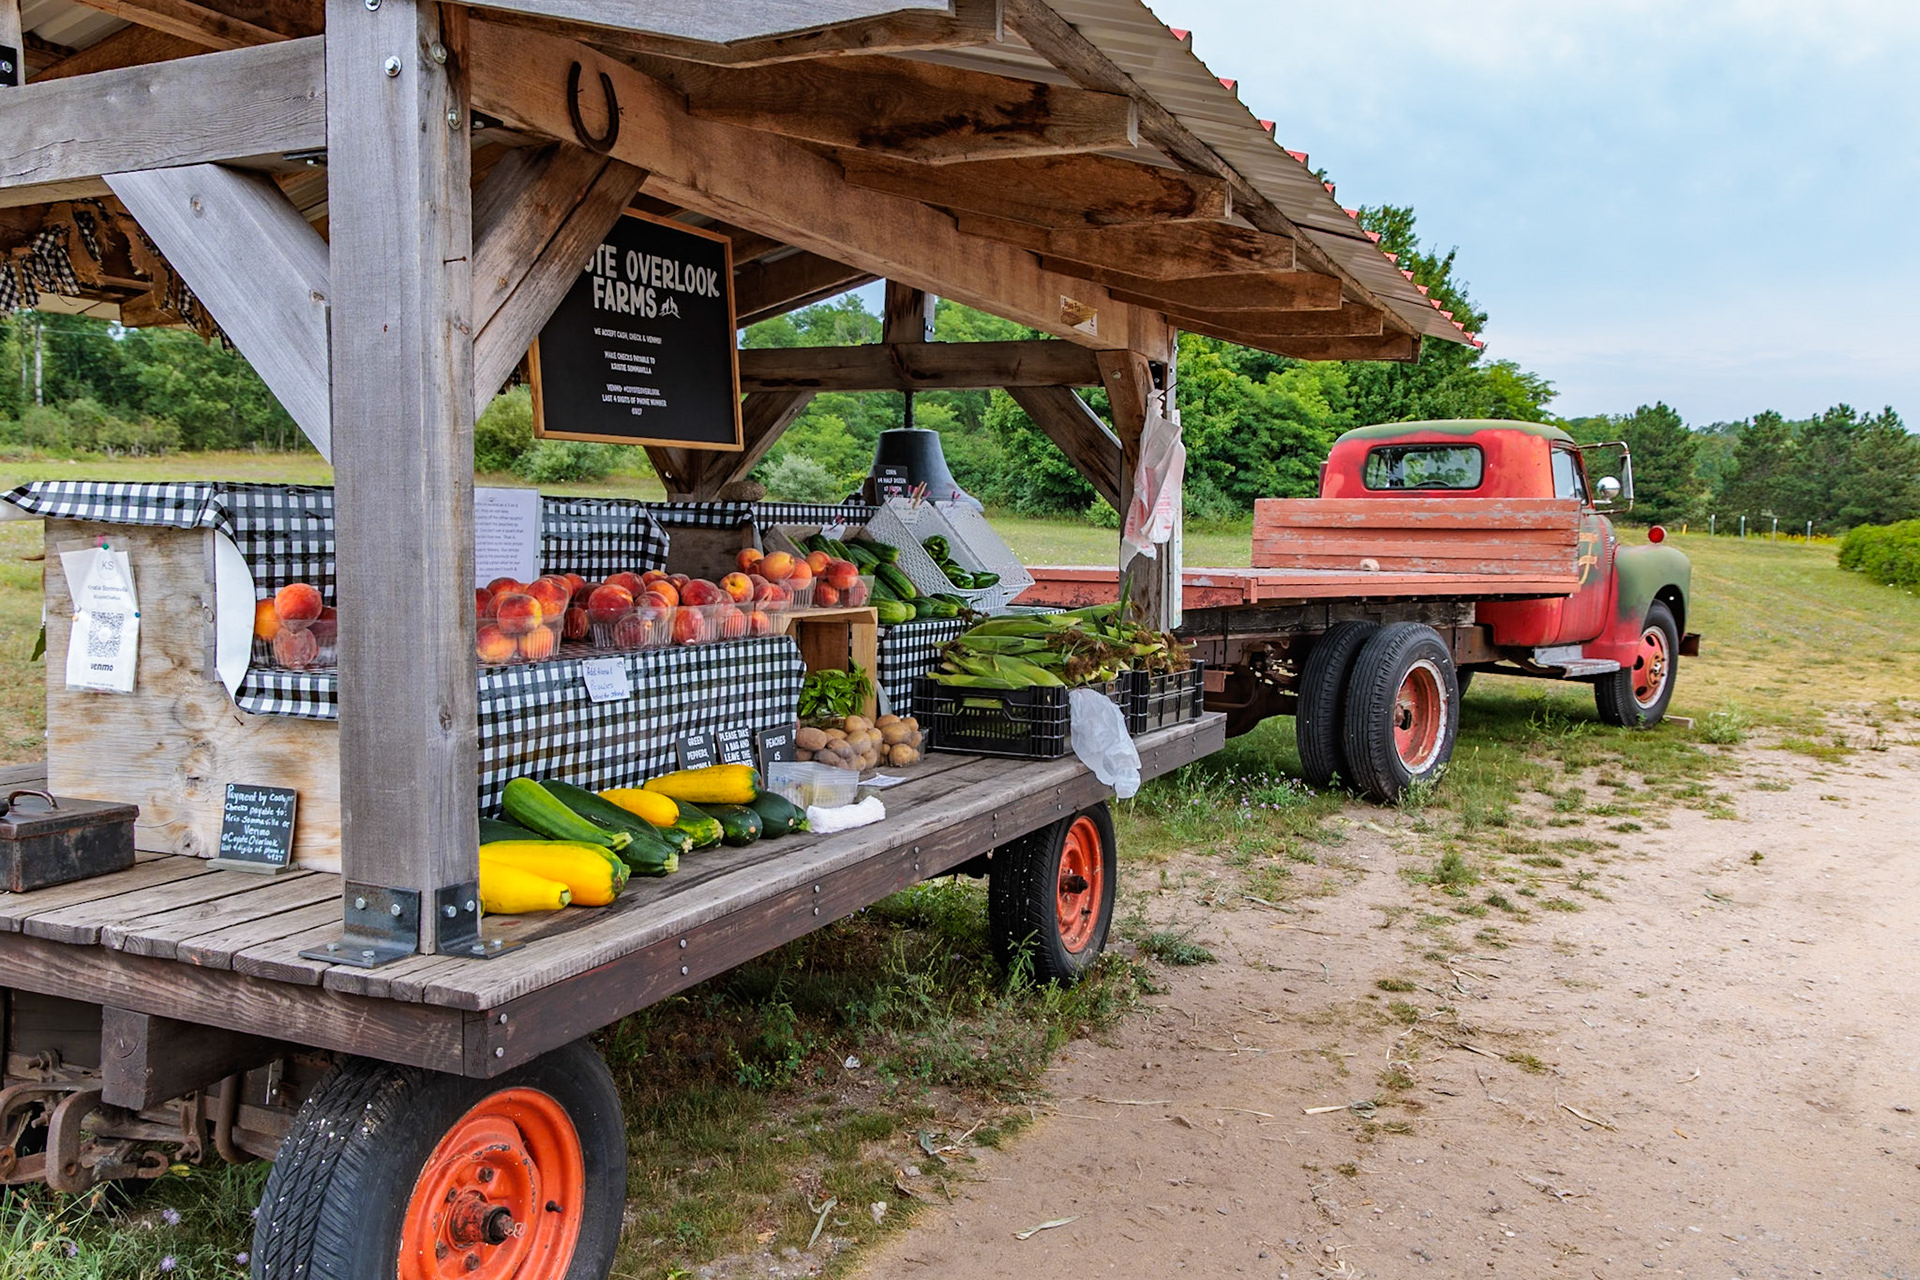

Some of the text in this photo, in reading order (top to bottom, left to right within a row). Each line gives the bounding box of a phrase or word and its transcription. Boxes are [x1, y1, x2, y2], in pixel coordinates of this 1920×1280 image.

[626, 250, 720, 297] OVERLOOK
[593, 276, 657, 318] FARMS
[594, 327, 601, 335] WE
[602, 329, 616, 337] ACCEPT
[629, 332, 642, 341] CHECK
[604, 351, 617, 359] MAKE
[617, 353, 633, 361] CHECKS
[633, 355, 650, 364] PAYABLE
[102, 561, 115, 571] KS
[91, 662, 114, 672] venmo
[687, 735, 704, 747] GREEN
[719, 728, 750, 742] PLEASE TAKE
[765, 735, 786, 748] PEACHES
[725, 739, 750, 753] A BAG AND
[686, 748, 710, 761] PEPPERS,
[724, 751, 740, 763] LEAVE
[741, 749, 751, 760] THE
[227, 785, 257, 804] Payment
[258, 791, 267, 806] by
[225, 803, 288, 817] Checks payable to:
[225, 813, 240, 822] Kris
[244, 825, 270, 836] Venmo
[254, 845, 263, 853] of
[264, 847, 280, 855] phone
